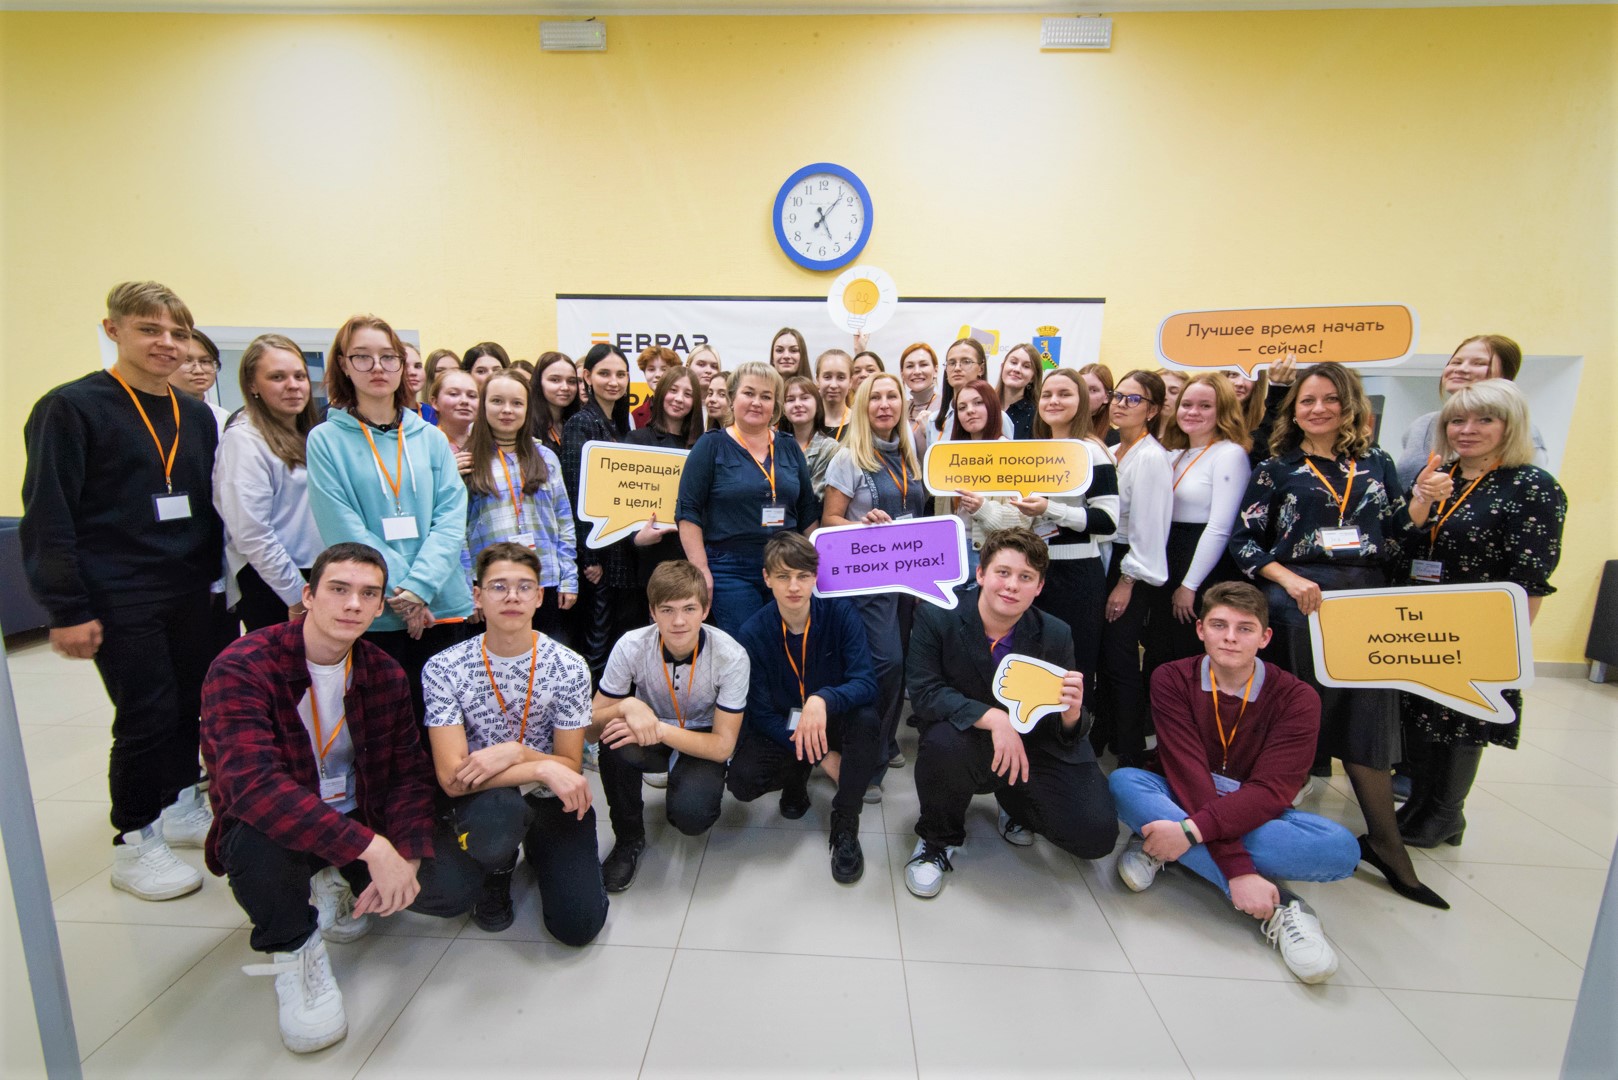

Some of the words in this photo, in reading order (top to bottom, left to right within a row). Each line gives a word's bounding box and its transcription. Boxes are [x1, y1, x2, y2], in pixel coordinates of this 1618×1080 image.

[805, 185, 813, 195] 11
[819, 180, 829, 191] 12
[793, 197, 803, 207] 10
[847, 196, 853, 207] 2
[789, 213, 797, 224] 9
[850, 214, 858, 224] 3
[794, 231, 802, 241] 8
[844, 232, 853, 241] 4
[806, 242, 812, 253] 7
[819, 246, 826, 257] 6
[833, 242, 841, 252] 5
[1186, 323, 1255, 340] Лучшее
[1261, 323, 1316, 338] время
[1322, 321, 1385, 333] начать
[1258, 340, 1324, 355] сейчас!
[600, 457, 681, 476] Превращай
[949, 453, 994, 468] Давай
[999, 454, 1066, 468] покорим
[944, 474, 991, 486] новую
[996, 470, 1071, 486] вершину?
[617, 480, 660, 492] мечты
[613, 497, 621, 506] в
[626, 497, 662, 509] цели!
[851, 542, 886, 555] Весь
[891, 539, 923, 552] мир
[831, 565, 840, 576] в
[844, 562, 889, 574] твоих
[894, 552, 945, 573] руках!
[1395, 606, 1423, 621] Ты
[1367, 632, 1460, 644] можешь
[1368, 650, 1462, 665] больше!
